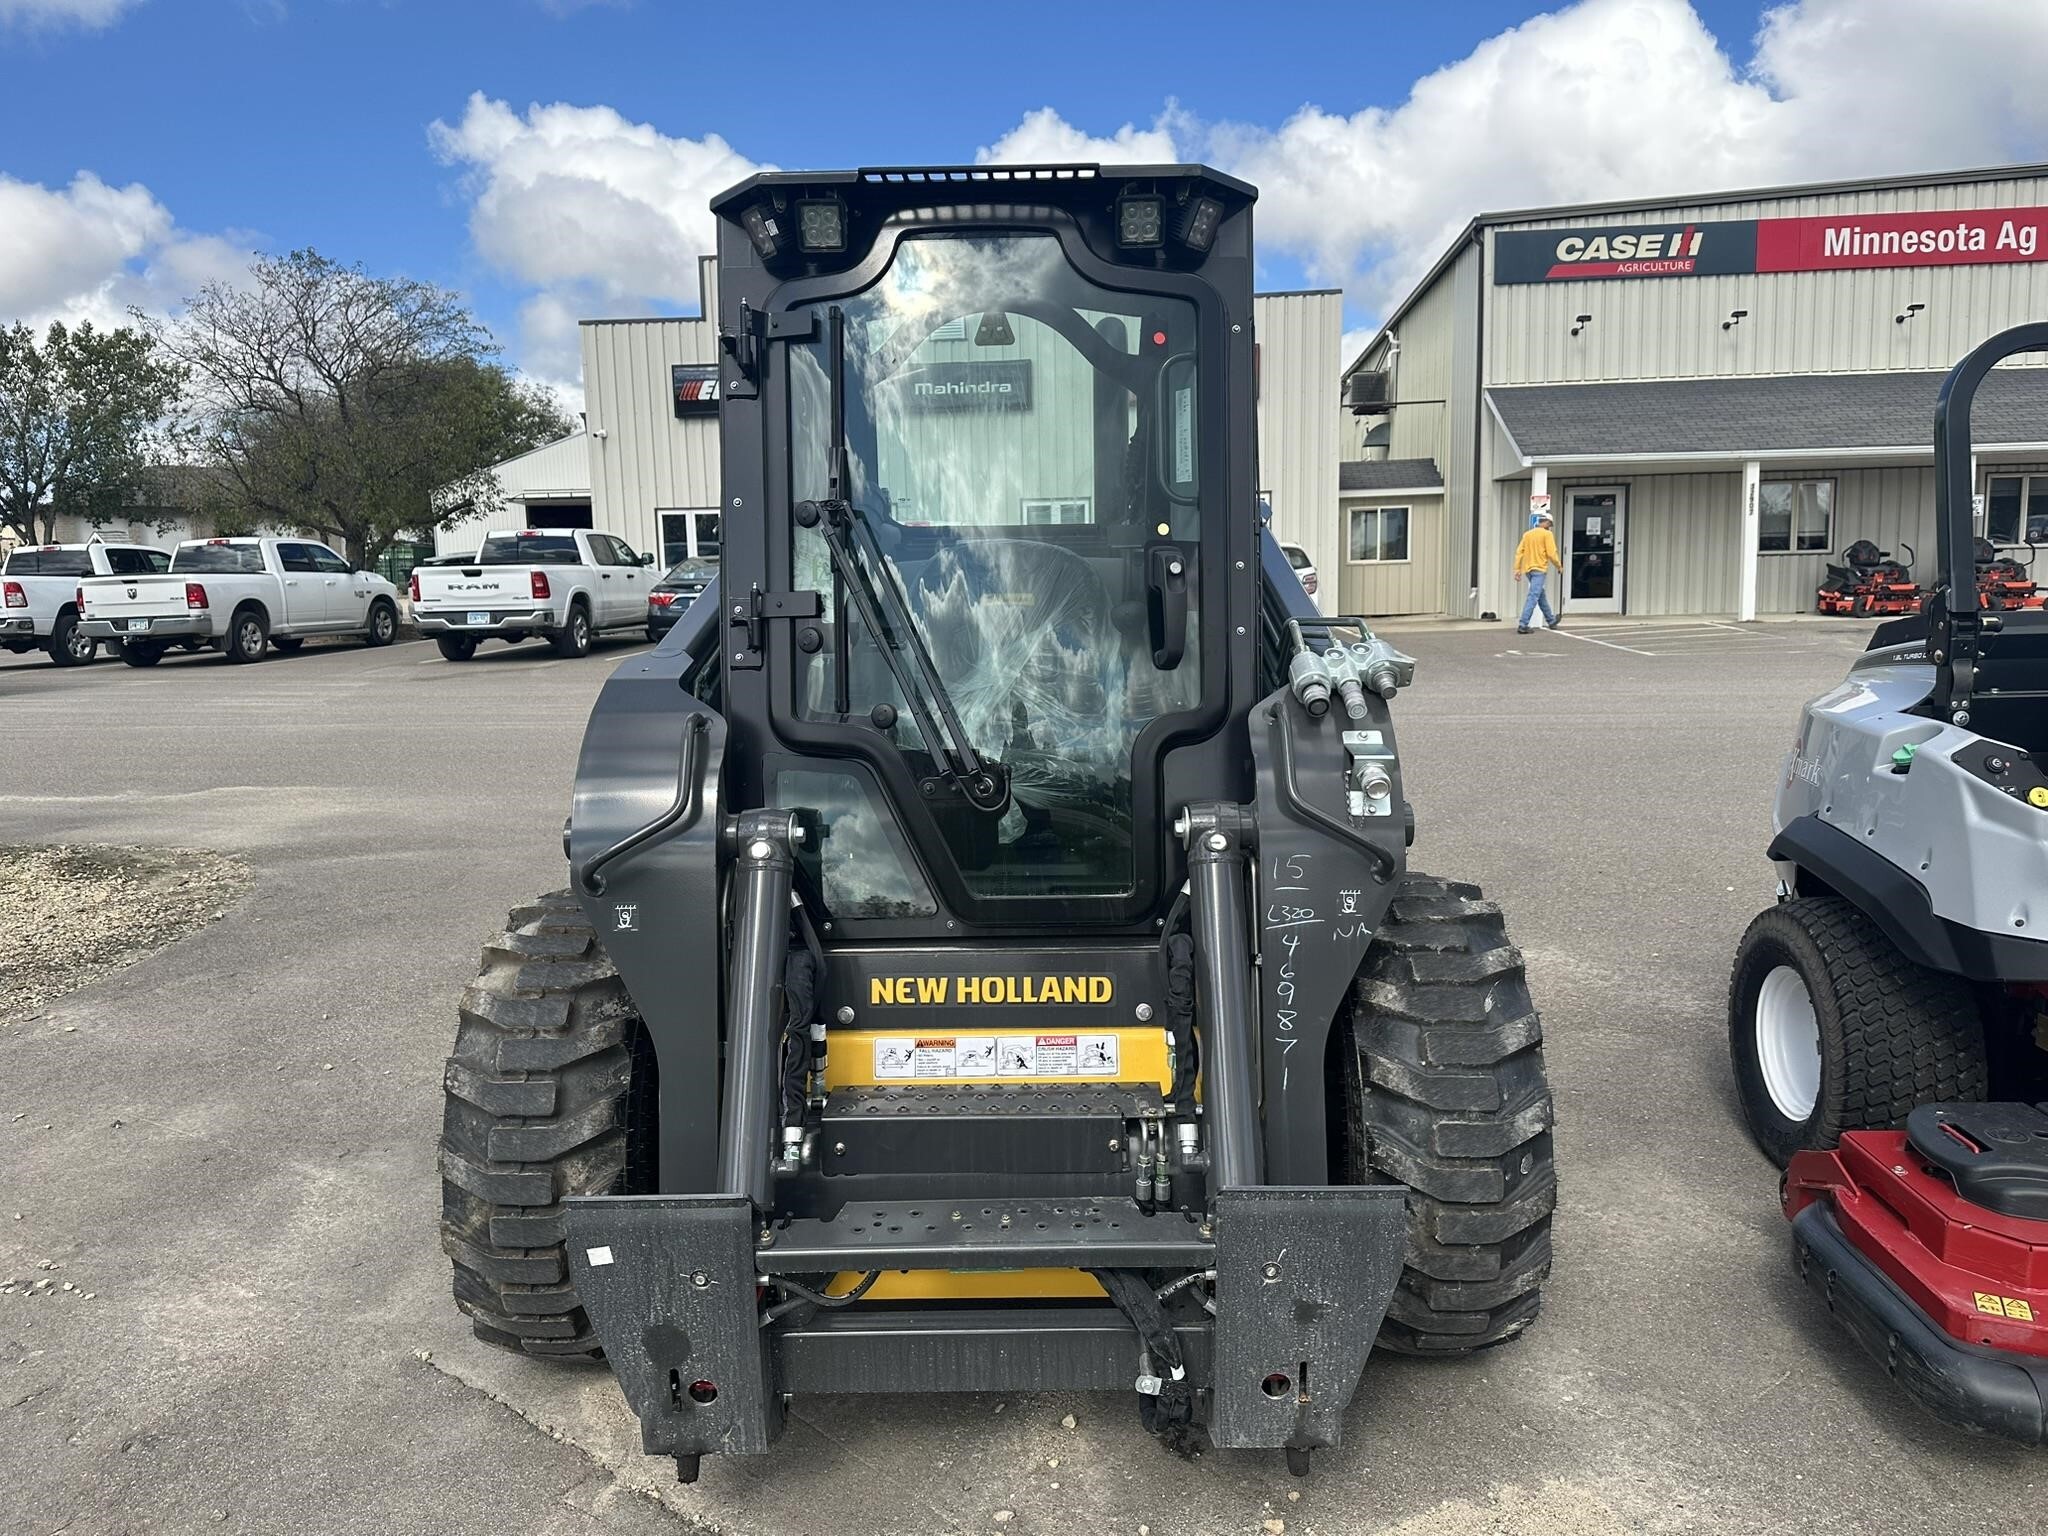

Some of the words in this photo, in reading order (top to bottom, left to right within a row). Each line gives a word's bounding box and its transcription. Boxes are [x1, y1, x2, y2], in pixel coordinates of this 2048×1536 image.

[1556, 232, 1667, 263] CASE
[1823, 227, 1985, 258] Minnesota
[1995, 220, 2037, 256] Ag
[1617, 259, 1692, 273] AGRICULTURE
[914, 381, 1012, 395] Mahindra
[1274, 855, 1312, 879] 15
[1267, 904, 1315, 922] L320
[870, 977, 948, 1004] NEW
[956, 976, 1113, 1003] HOLLAND
[923, 1039, 955, 1047] WARNING
[1046, 1037, 1075, 1045] DANGER
